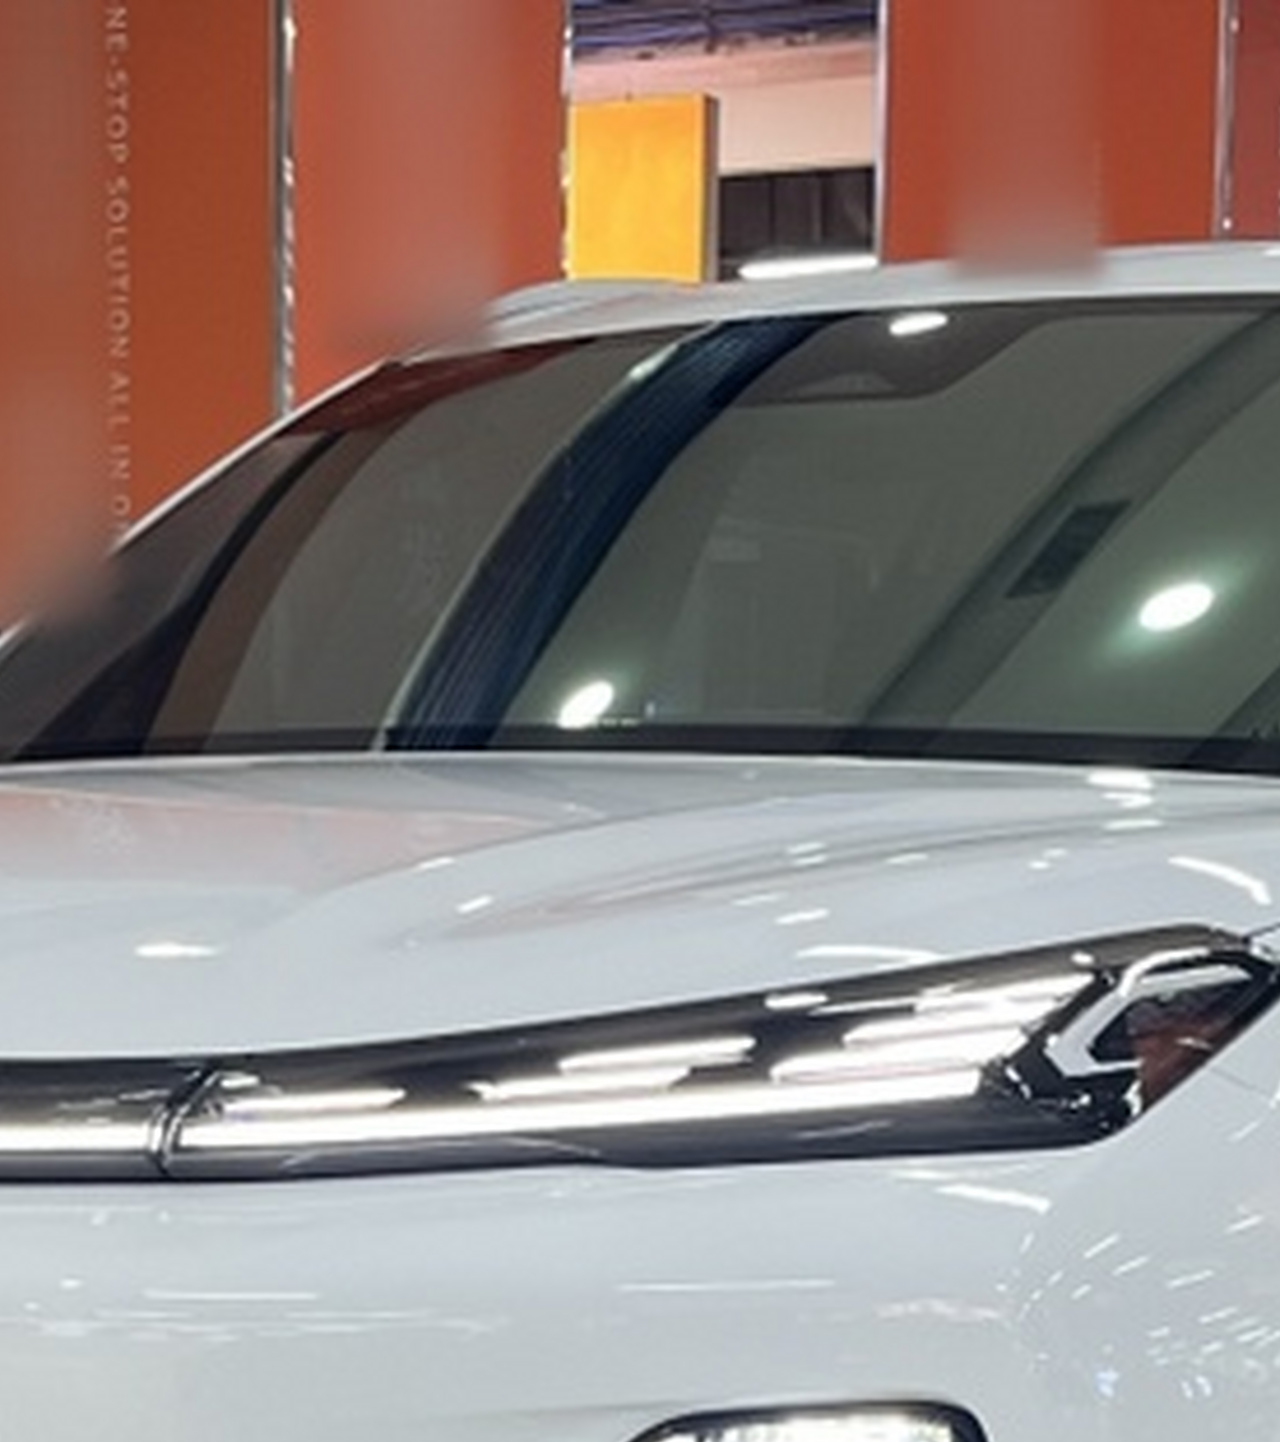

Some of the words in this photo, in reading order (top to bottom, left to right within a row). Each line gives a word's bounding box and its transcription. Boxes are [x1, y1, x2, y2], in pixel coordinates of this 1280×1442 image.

[104, 0, 131, 163] NE-STOP
[106, 176, 132, 357] SOLUTION
[108, 372, 132, 425] ALL
[109, 444, 132, 480] IN
